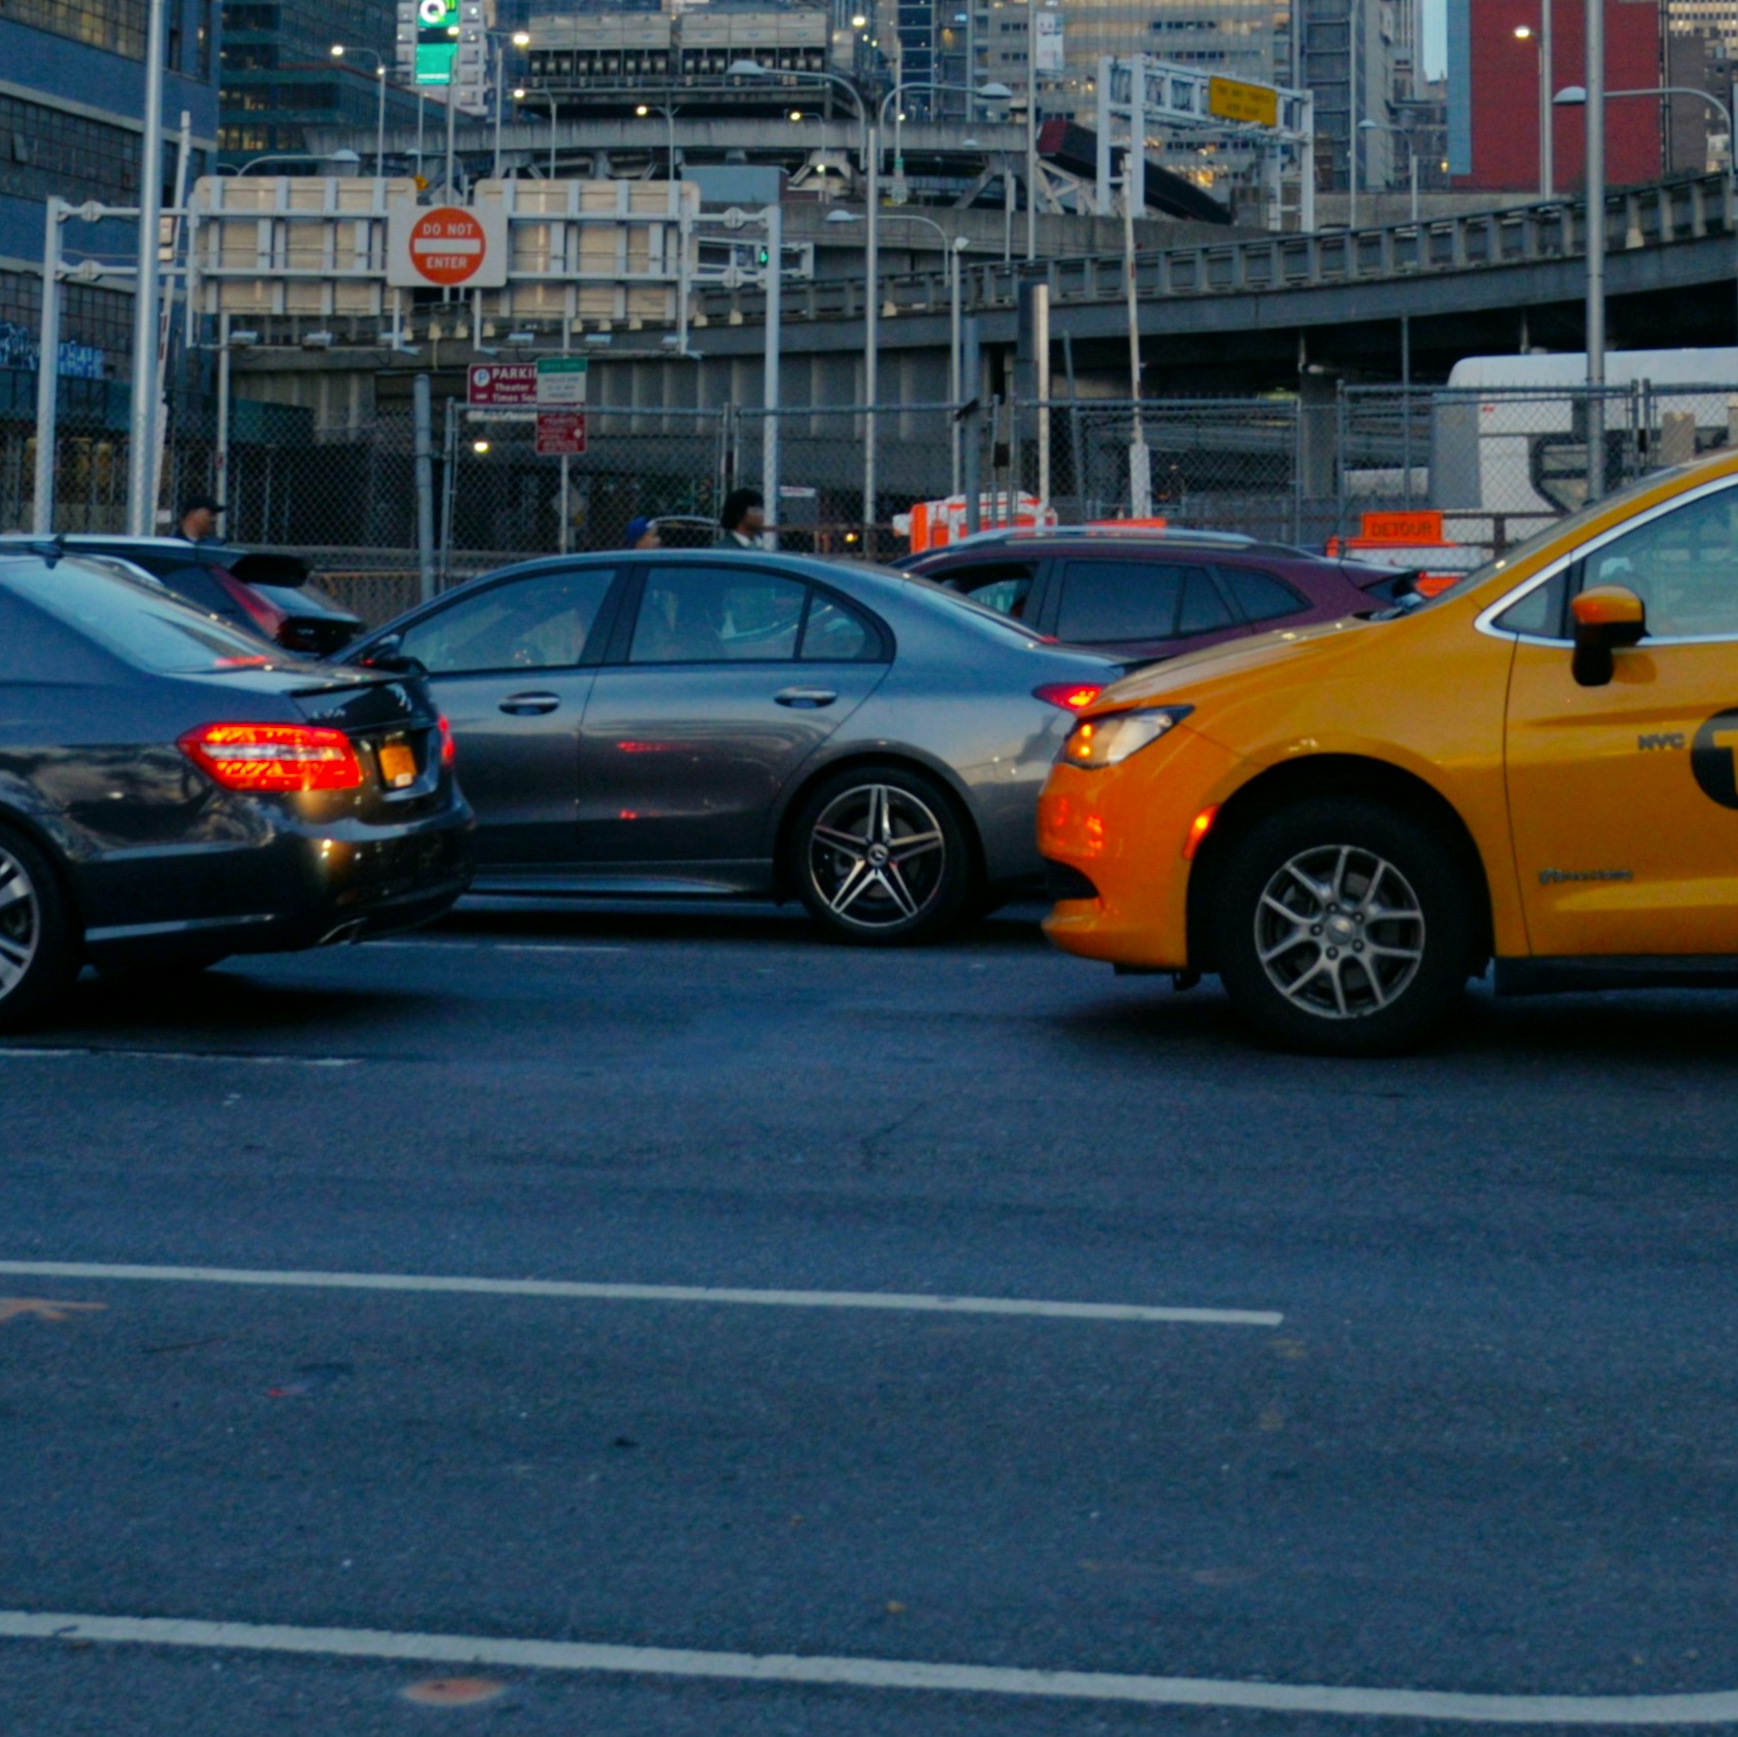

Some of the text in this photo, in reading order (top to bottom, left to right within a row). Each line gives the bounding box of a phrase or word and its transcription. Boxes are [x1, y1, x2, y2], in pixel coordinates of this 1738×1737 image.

[422, 223, 474, 236] DO NOT
[425, 255, 468, 270] ENTER
[491, 367, 537, 380] PARKI
[494, 382, 530, 393] Theater
[491, 393, 519, 403] Times
[1372, 521, 1432, 538] DETOUR
[1637, 732, 1686, 751] NYC
